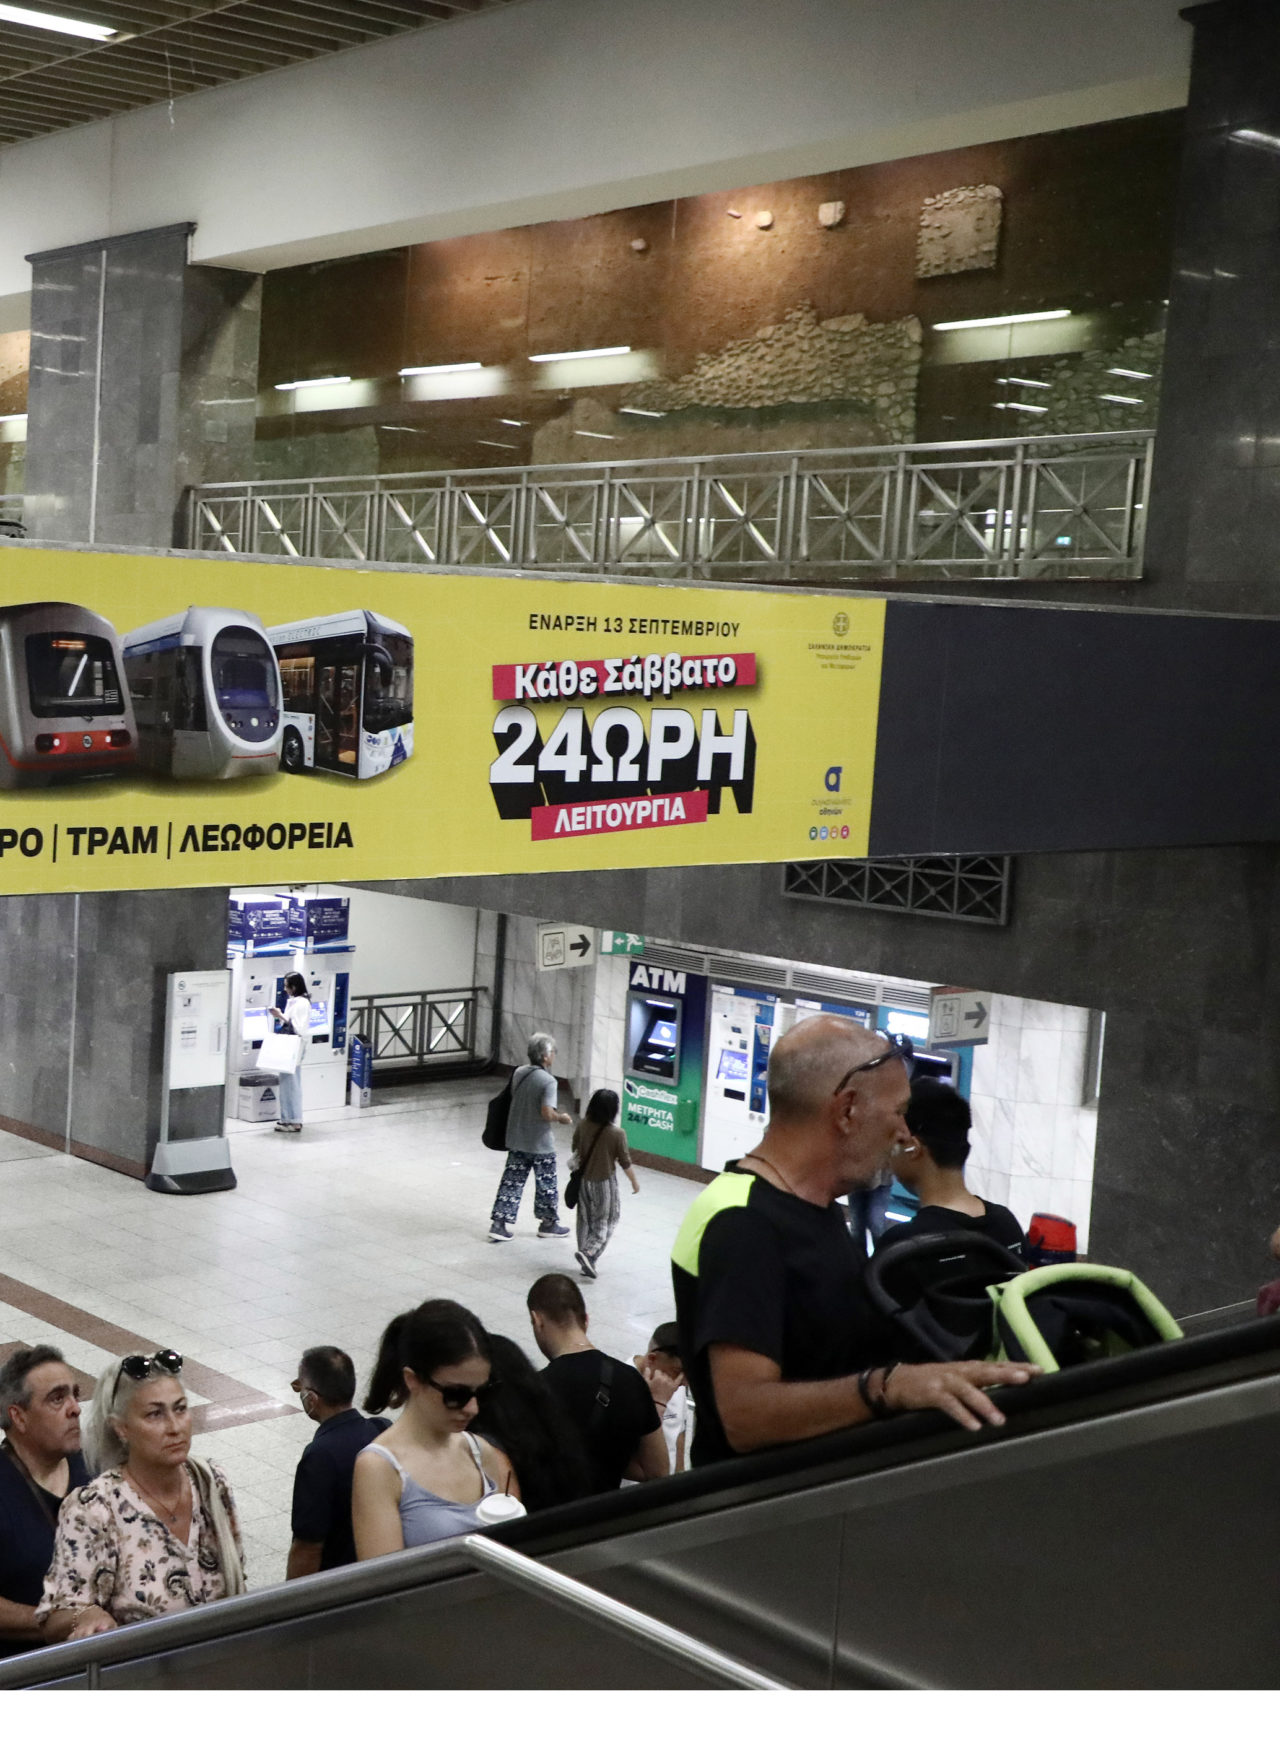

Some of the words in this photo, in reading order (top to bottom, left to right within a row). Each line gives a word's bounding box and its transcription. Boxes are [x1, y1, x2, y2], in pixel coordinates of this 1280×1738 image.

[528, 613, 598, 633] ΕΝΑΡΞΗ
[603, 616, 624, 634] 13
[628, 617, 740, 638] ΣΕΠΤΕΜΒΡΙΟΥ
[514, 661, 598, 699] Κάθε
[603, 652, 736, 694] Σάββατο
[489, 705, 749, 784] 24ΩΡΗ
[554, 796, 686, 834] ΛΕΙΤΟΥΡΓΙΑ
[65, 825, 159, 856] ΤΡΑΜ
[179, 821, 354, 854] ΛΕΩΦΟΡΕΙΑ
[631, 965, 686, 995] ATM
[628, 1102, 673, 1122] ΜΕΤΡΗΤΑ
